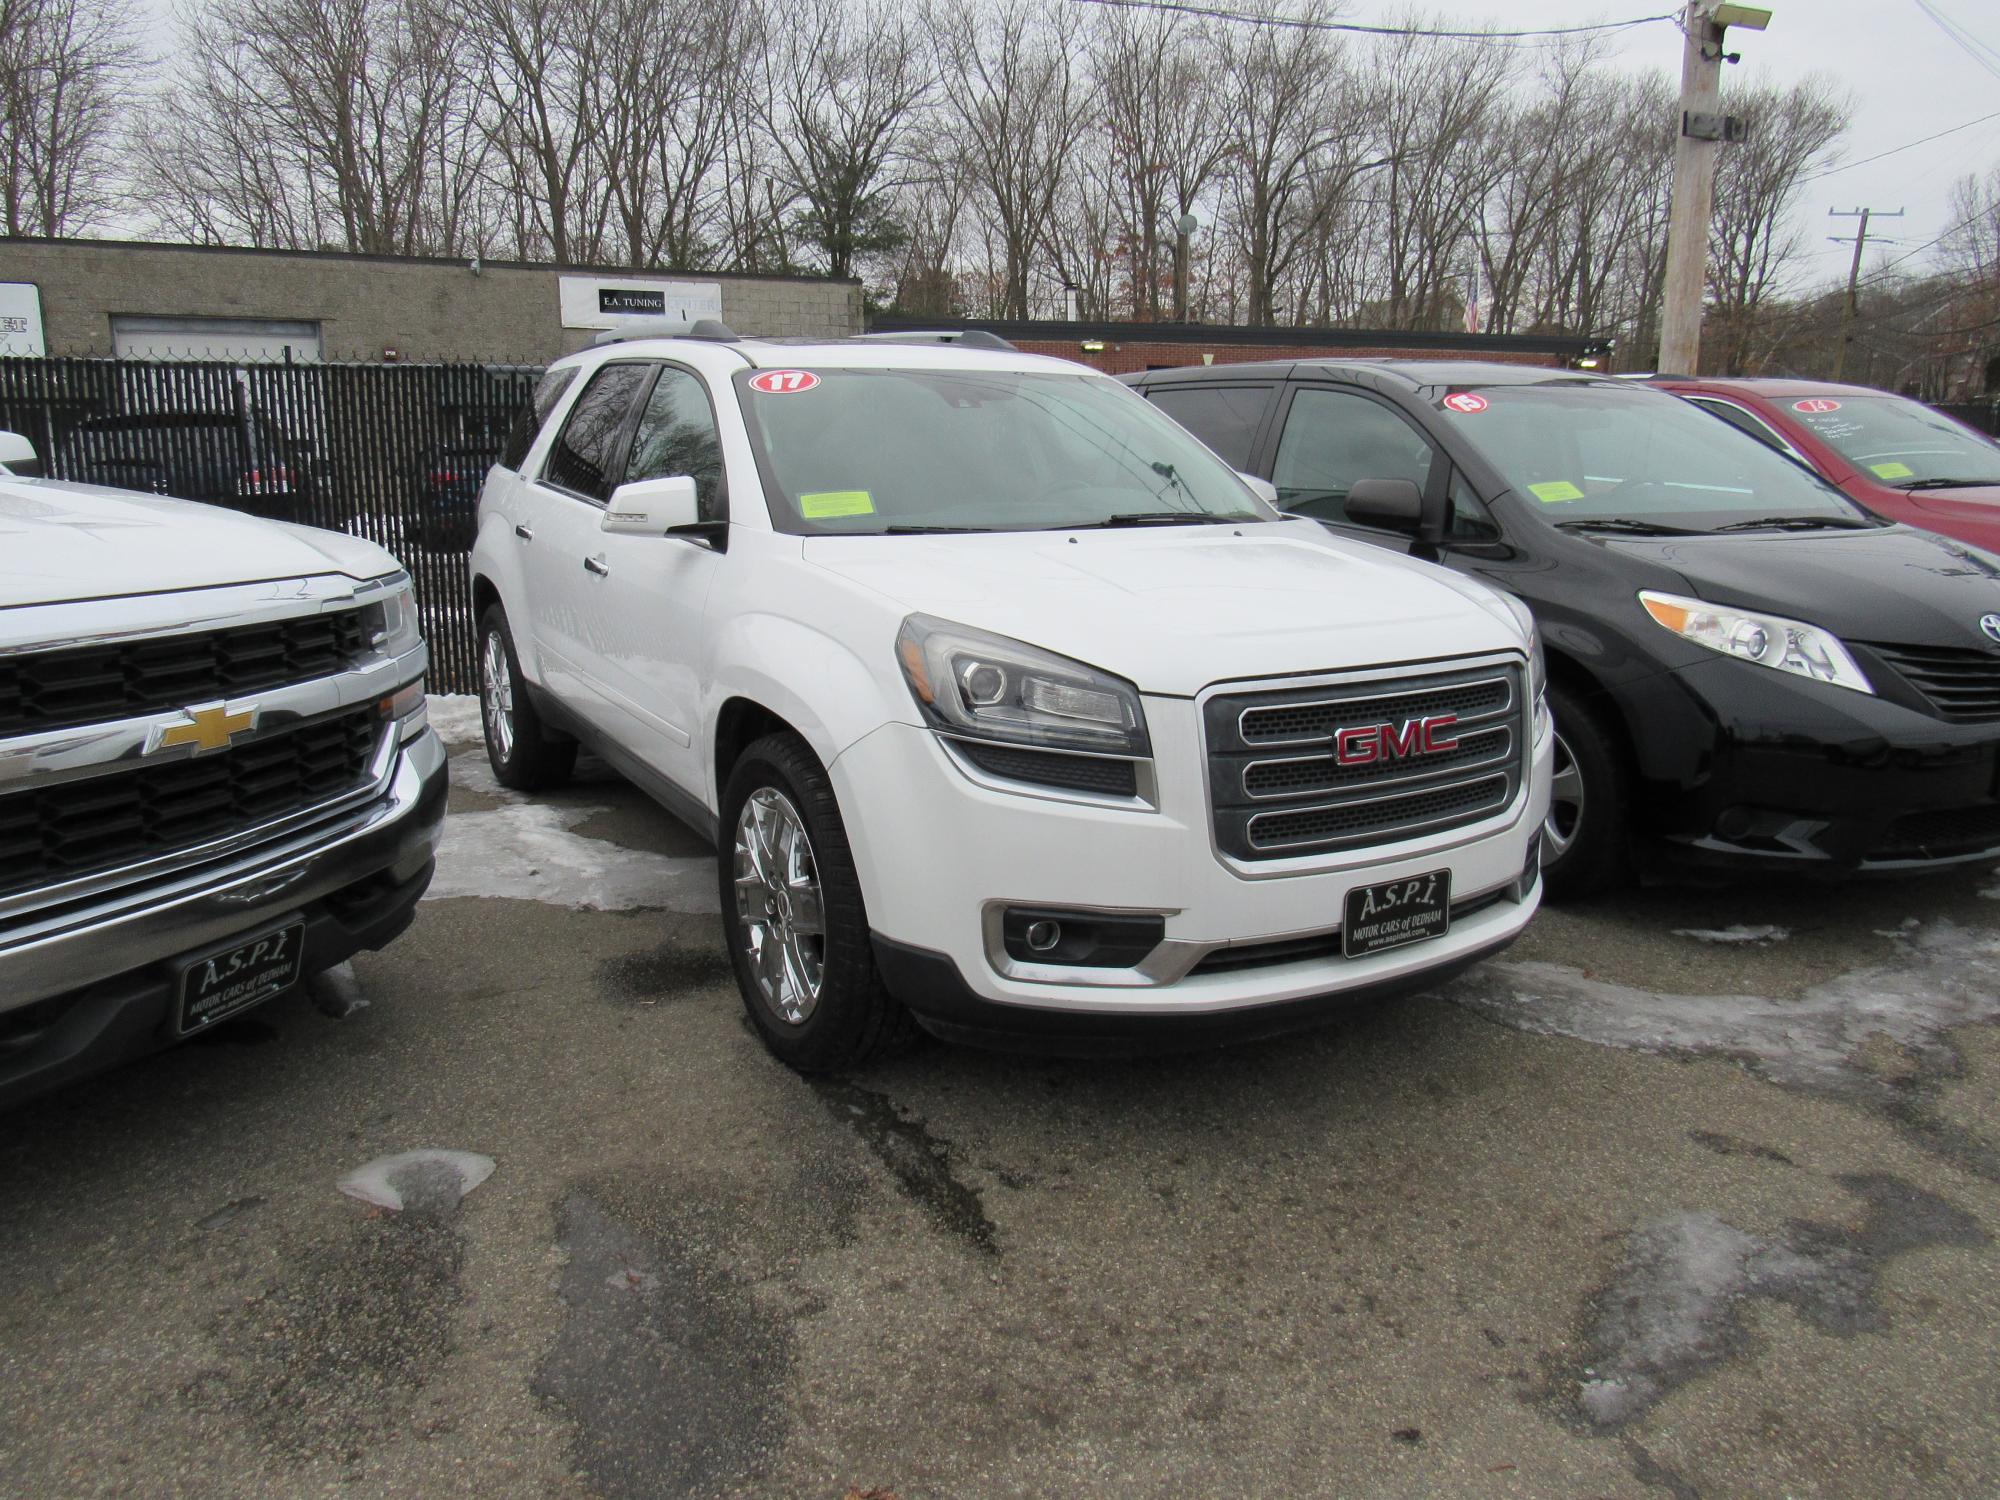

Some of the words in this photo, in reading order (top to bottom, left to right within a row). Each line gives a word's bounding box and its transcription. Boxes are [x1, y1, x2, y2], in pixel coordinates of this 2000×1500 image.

[623, 298, 662, 308] TUNING
[768, 372, 804, 390] 17
[1334, 713, 1458, 766] GMC
[1352, 924, 1379, 942] MOTOR
[1380, 918, 1400, 934] CARS
[1401, 913, 1411, 930] of
[1412, 909, 1442, 928] DEDHAM
[190, 990, 222, 1016] MOTOR
[222, 981, 245, 1002] CARS
[257, 961, 292, 986] DEDHAM
